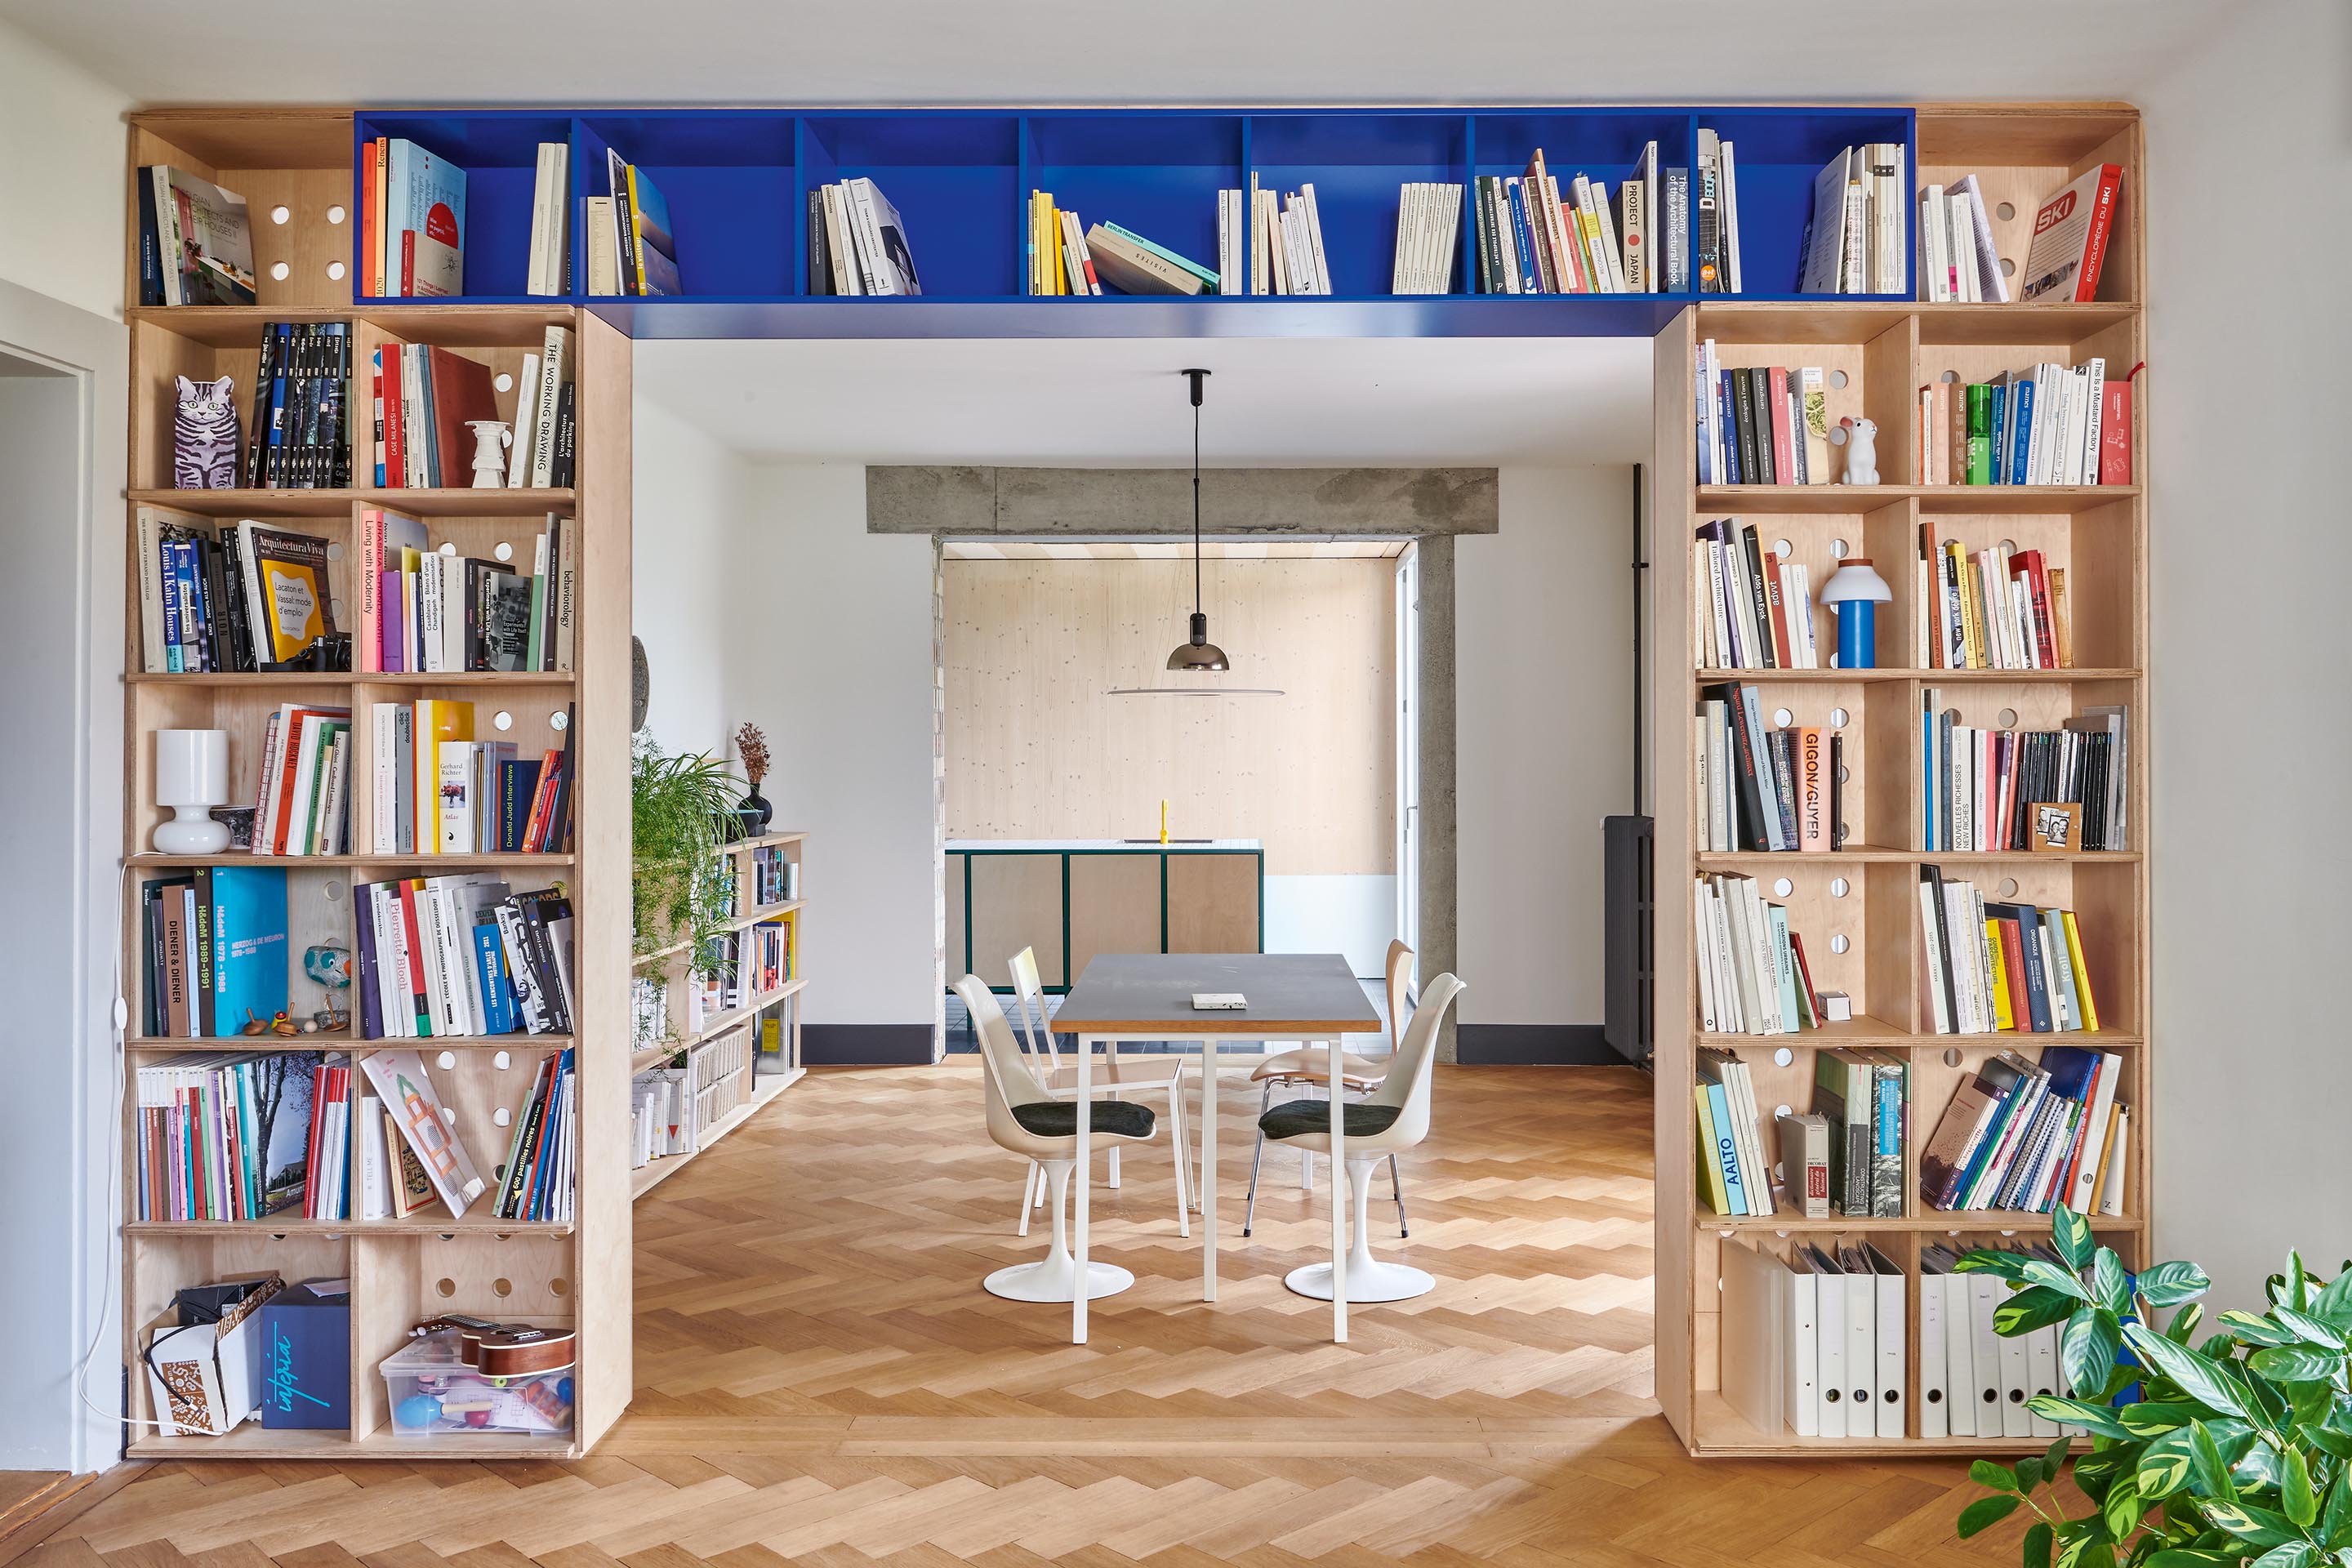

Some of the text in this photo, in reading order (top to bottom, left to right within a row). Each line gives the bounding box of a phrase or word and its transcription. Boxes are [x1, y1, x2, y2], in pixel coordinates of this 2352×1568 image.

[377, 139, 385, 168] Renens
[1669, 176, 1677, 184] of
[160, 198, 169, 229] ARCHITECTS
[1628, 185, 1638, 226] PROJECT
[1678, 176, 1688, 234] The Anatomy
[2037, 198, 2070, 231] SKI
[1107, 223, 1144, 245] BERLIN TRANSFER
[1669, 204, 1678, 261] Architectural
[2086, 186, 2111, 282] ENCYCLOPÉDIE DU SKI
[1135, 252, 1167, 274] VISITES
[1630, 254, 1638, 284] JAPAN
[1669, 263, 1678, 285] Book
[1702, 267, 1714, 276] a+t
[376, 277, 384, 295] 1020
[2094, 361, 2103, 377] This
[537, 344, 557, 470] THE WORKING DRAWING
[2092, 393, 2100, 423] Mustard
[558, 414, 568, 457] L'architecture
[565, 421, 574, 457] du parking
[2058, 427, 2066, 451] Architecture
[2088, 424, 2098, 452] Factory
[162, 544, 172, 570] Louis
[363, 520, 373, 614] Living with Modernity
[164, 579, 173, 604] Kahn
[274, 581, 296, 594] Lacaton
[1711, 545, 1723, 619] Tailored Architecture
[1753, 574, 1762, 590] Aldo
[1758, 604, 1766, 620] Eyck
[1770, 581, 1780, 606] advvt
[278, 606, 304, 617] d'emploi
[295, 596, 312, 607] mode
[560, 570, 573, 628] behaviorology
[165, 607, 176, 641] Houses
[217, 611, 228, 636] NOIR
[287, 722, 301, 770] DAVID HOCKNEY
[1756, 737, 1764, 760] Construction
[1806, 733, 1819, 839] GIGON/GUYER
[216, 905, 225, 938] H&deM
[432, 898, 441, 929] DÜSSELDORF
[499, 913, 509, 934] Banksy
[169, 920, 178, 956] DIENER
[217, 941, 225, 962] 1978
[390, 903, 408, 991] Pierrette Bloch
[2030, 929, 2038, 956] ORGANIQUE
[437, 936, 447, 973] PHOTOGRAPHIE
[2057, 956, 2070, 982] Kroll
[171, 969, 180, 1004] DIENER
[513, 1127, 535, 1189] 600 pastilles noires
[1720, 1138, 1740, 1185] AALTO
[287, 1187, 305, 1198] Amunt
